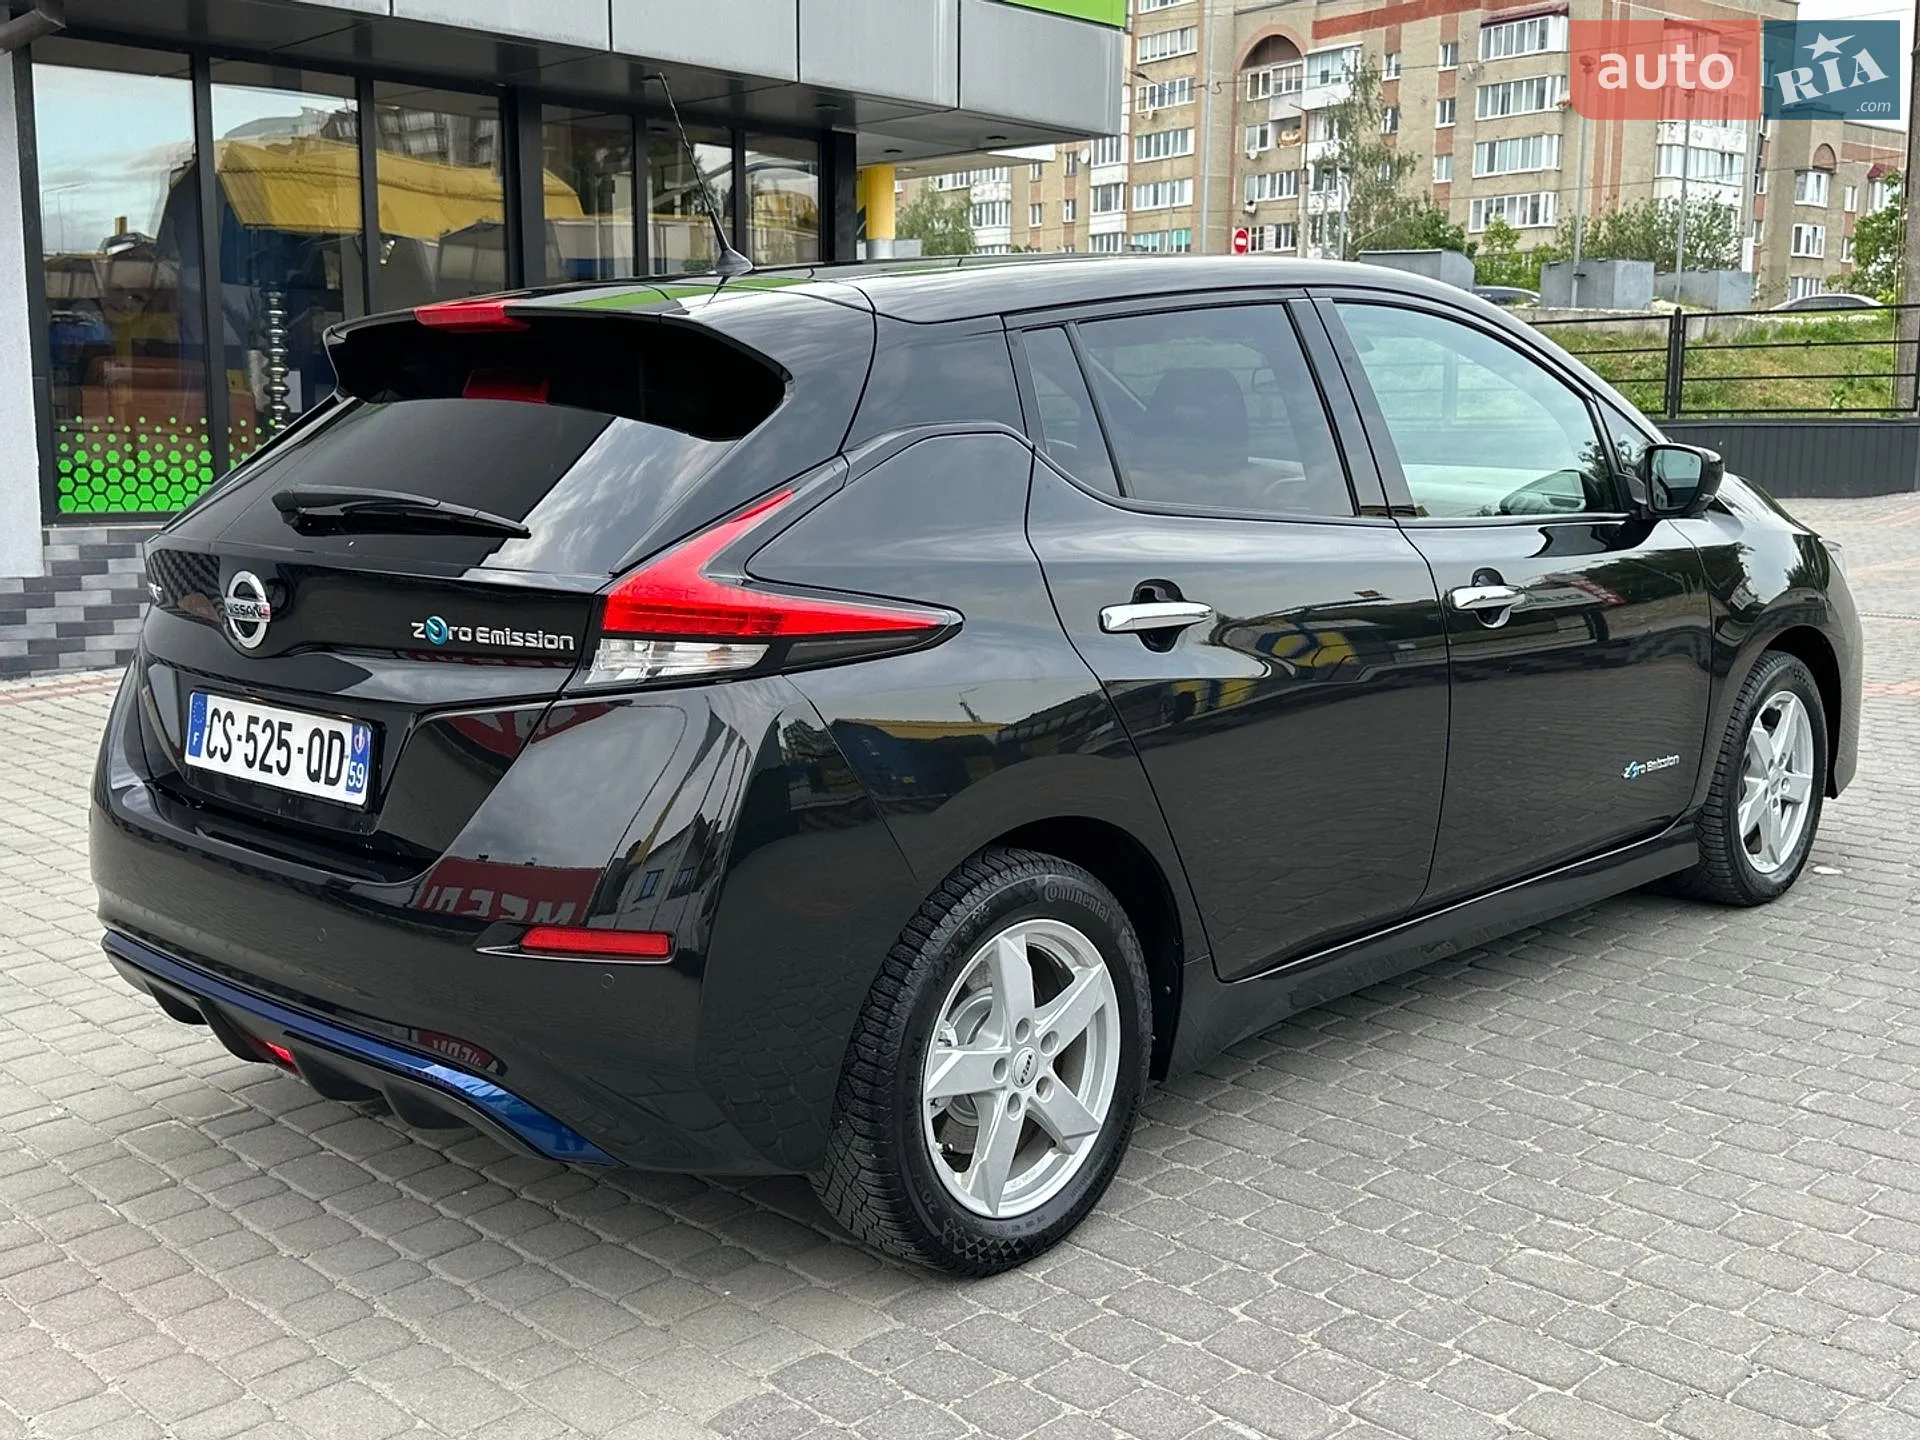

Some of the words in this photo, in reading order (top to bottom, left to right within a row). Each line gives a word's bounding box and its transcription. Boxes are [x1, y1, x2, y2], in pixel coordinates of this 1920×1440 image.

[476, 627, 575, 650] Emission
[193, 732, 199, 745] F
[206, 707, 345, 787] CS-525-QD
[348, 762, 364, 788] 59
[1044, 881, 1111, 922] Continental
